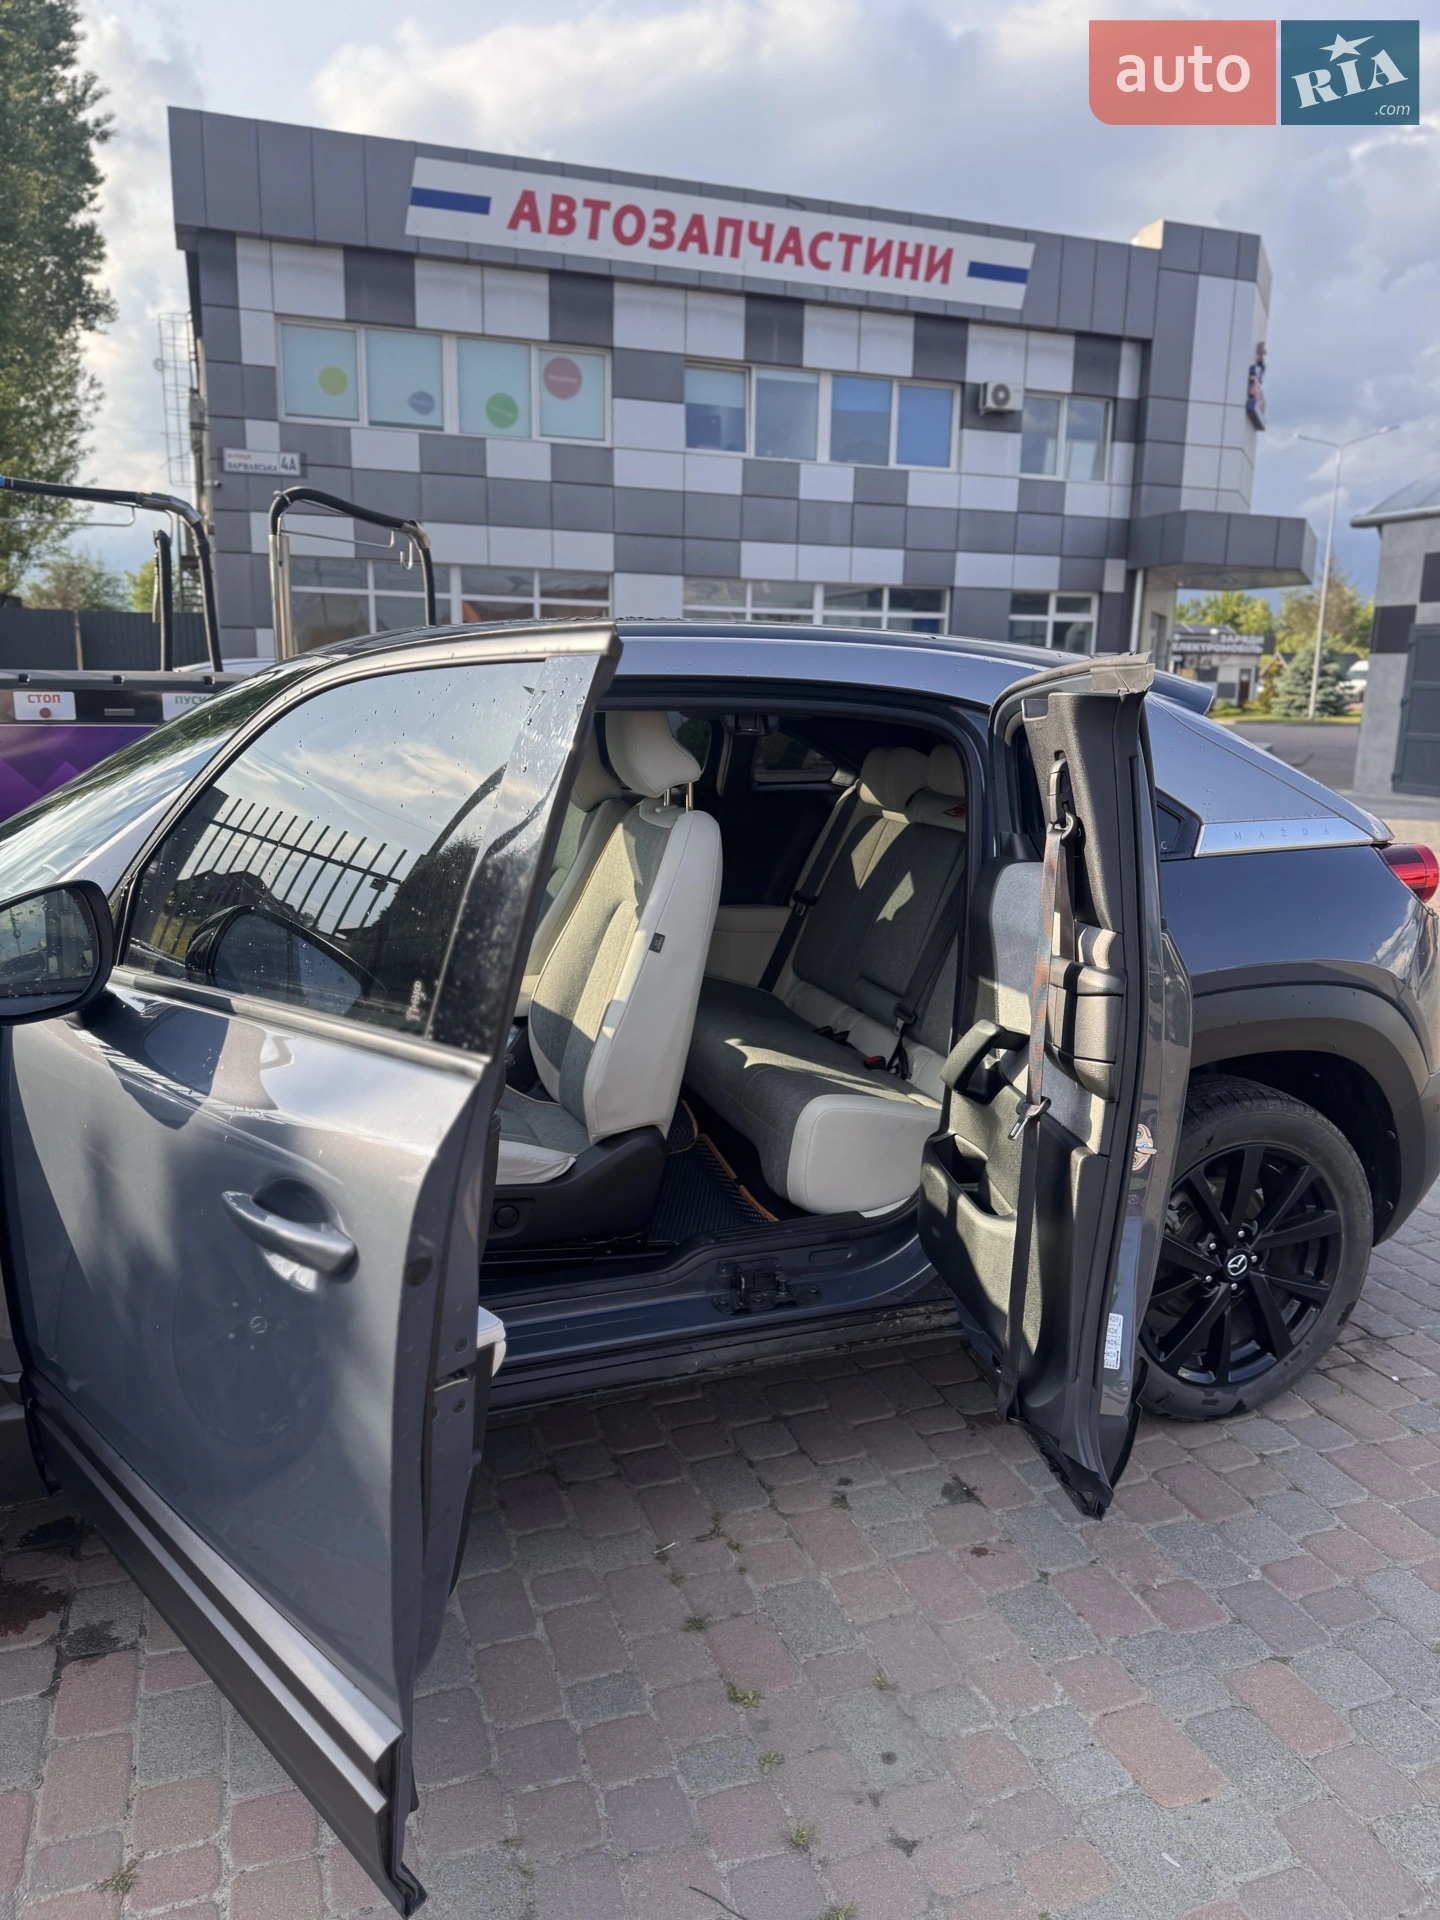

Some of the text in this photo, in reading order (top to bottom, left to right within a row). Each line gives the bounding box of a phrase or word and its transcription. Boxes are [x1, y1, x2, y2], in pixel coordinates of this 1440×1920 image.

[506, 189, 955, 285] АВТОЗАПЧАСТИНИ
[27, 694, 61, 704] СТОП
[1233, 828, 1330, 840] MAZDA
